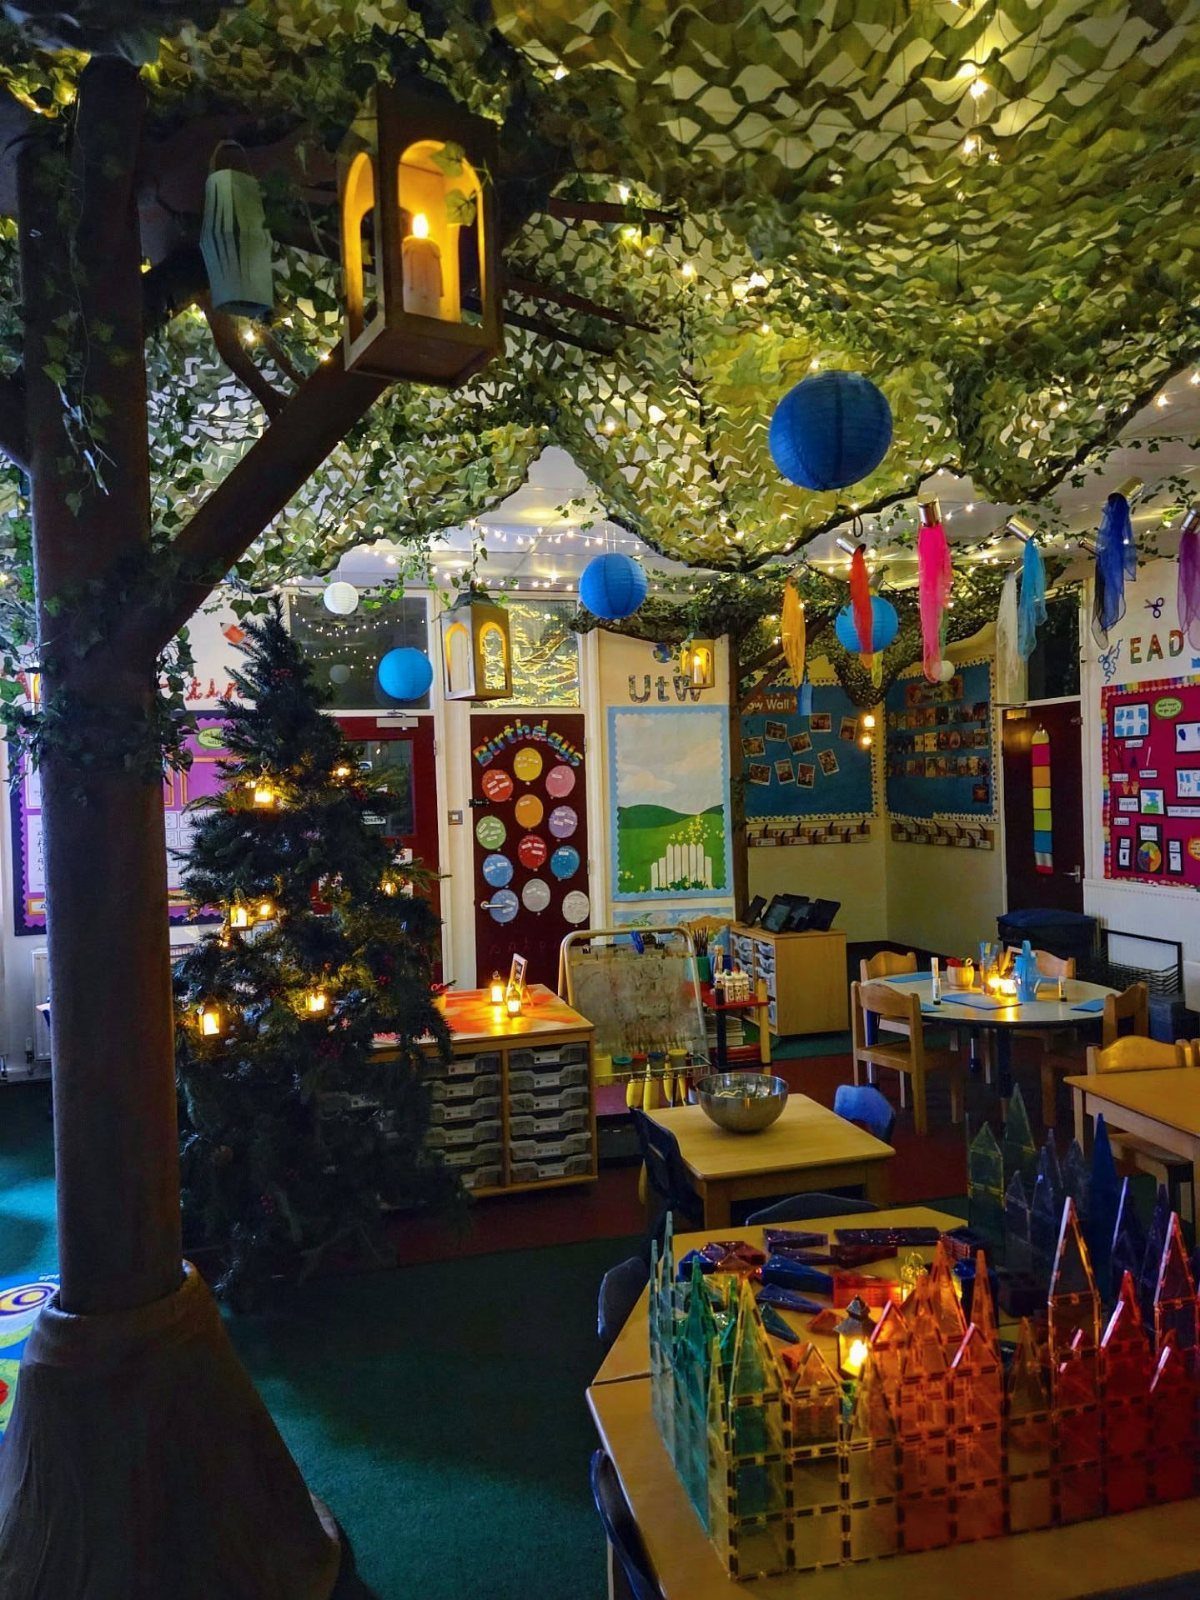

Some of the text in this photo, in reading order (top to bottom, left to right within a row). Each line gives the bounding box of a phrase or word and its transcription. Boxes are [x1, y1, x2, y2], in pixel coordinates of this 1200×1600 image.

[1129, 630, 1185, 665] EAD
[766, 698, 790, 710] Wall
[472, 718, 584, 767] Birthdays
